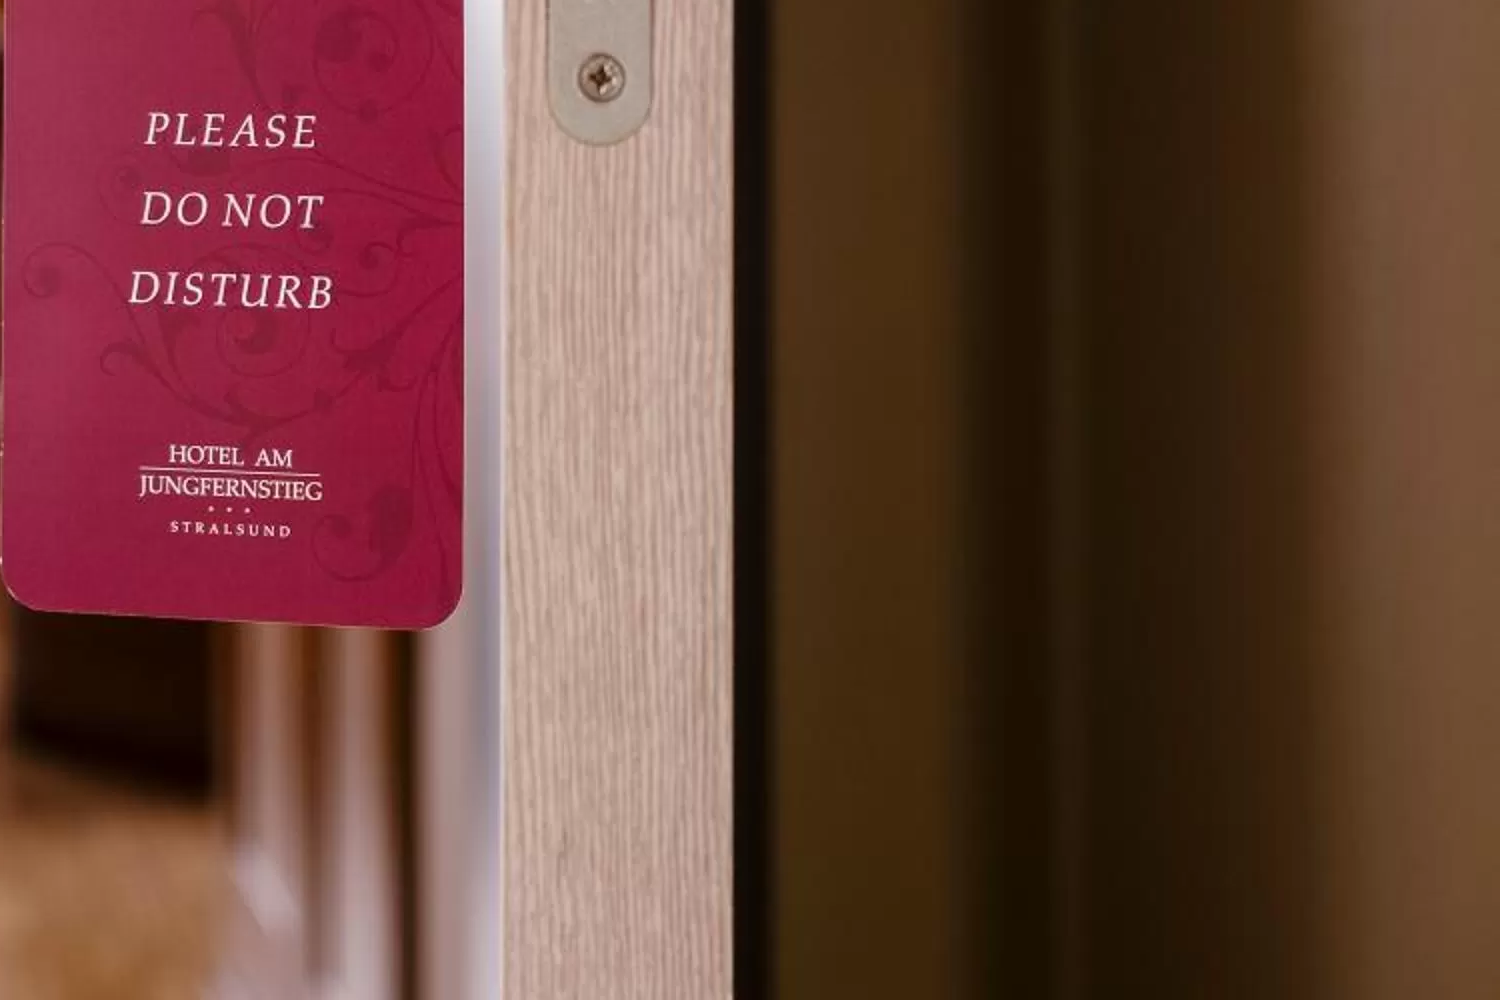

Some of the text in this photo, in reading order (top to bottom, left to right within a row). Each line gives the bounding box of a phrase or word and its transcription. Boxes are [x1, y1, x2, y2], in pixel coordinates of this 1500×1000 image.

[144, 112, 317, 148] PLEASE
[140, 191, 324, 228] DO NOT
[128, 271, 333, 309] DISTURB
[169, 444, 293, 468] HOTEL AM
[139, 475, 323, 501] JUNGFERNSTIEG
[169, 520, 291, 538] STRALSUND
